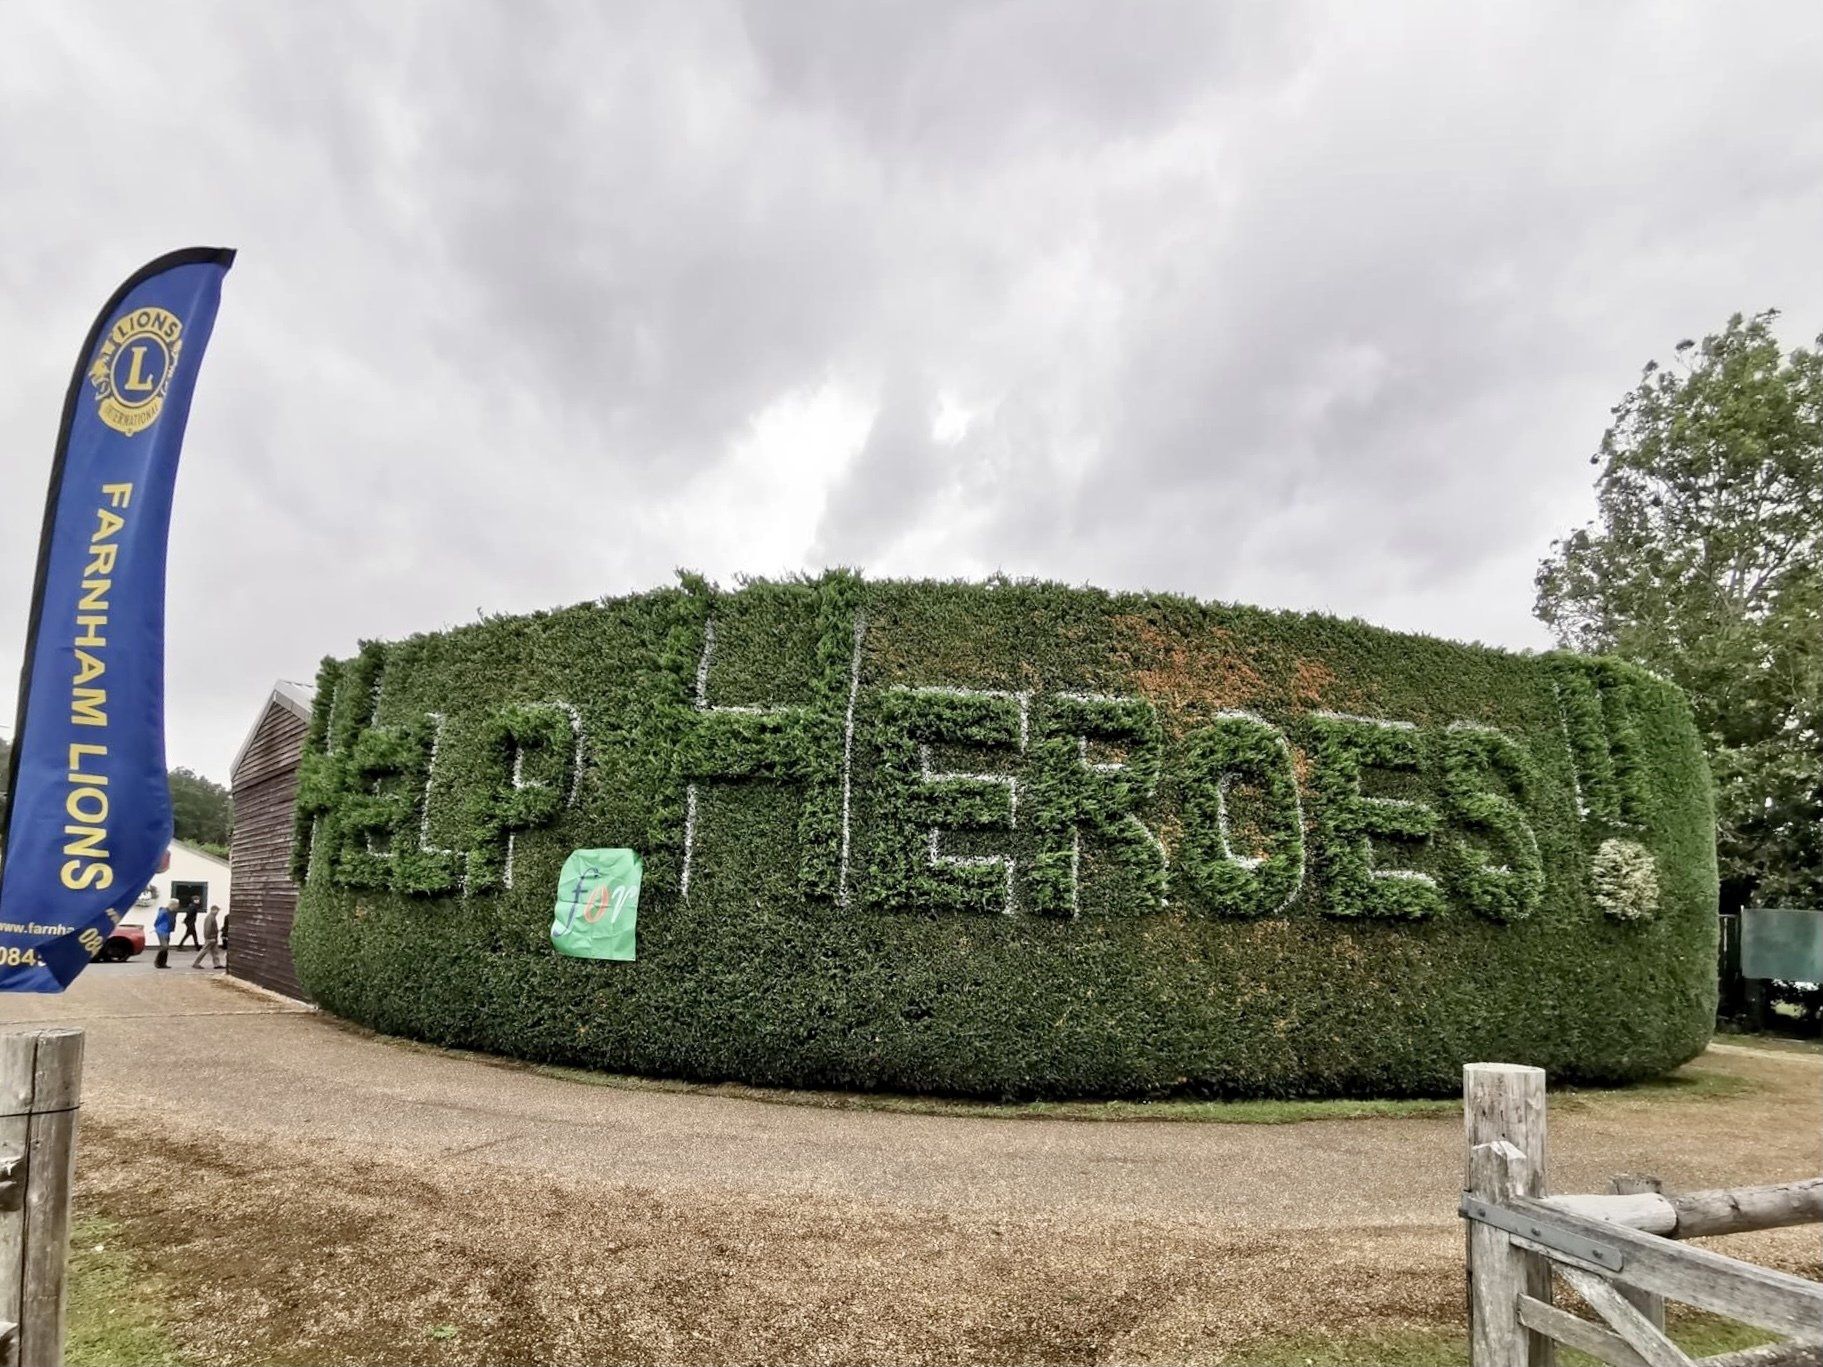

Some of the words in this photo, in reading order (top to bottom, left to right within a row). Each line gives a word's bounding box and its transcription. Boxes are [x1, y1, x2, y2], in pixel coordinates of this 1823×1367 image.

[116, 311, 179, 339] LIONS
[124, 346, 154, 391] L
[104, 402, 160, 426] INTERNATIONAL
[69, 482, 134, 728] FARNHAM
[289, 638, 587, 897] HELP
[60, 742, 114, 891] LIONS
[551, 867, 638, 938] for
